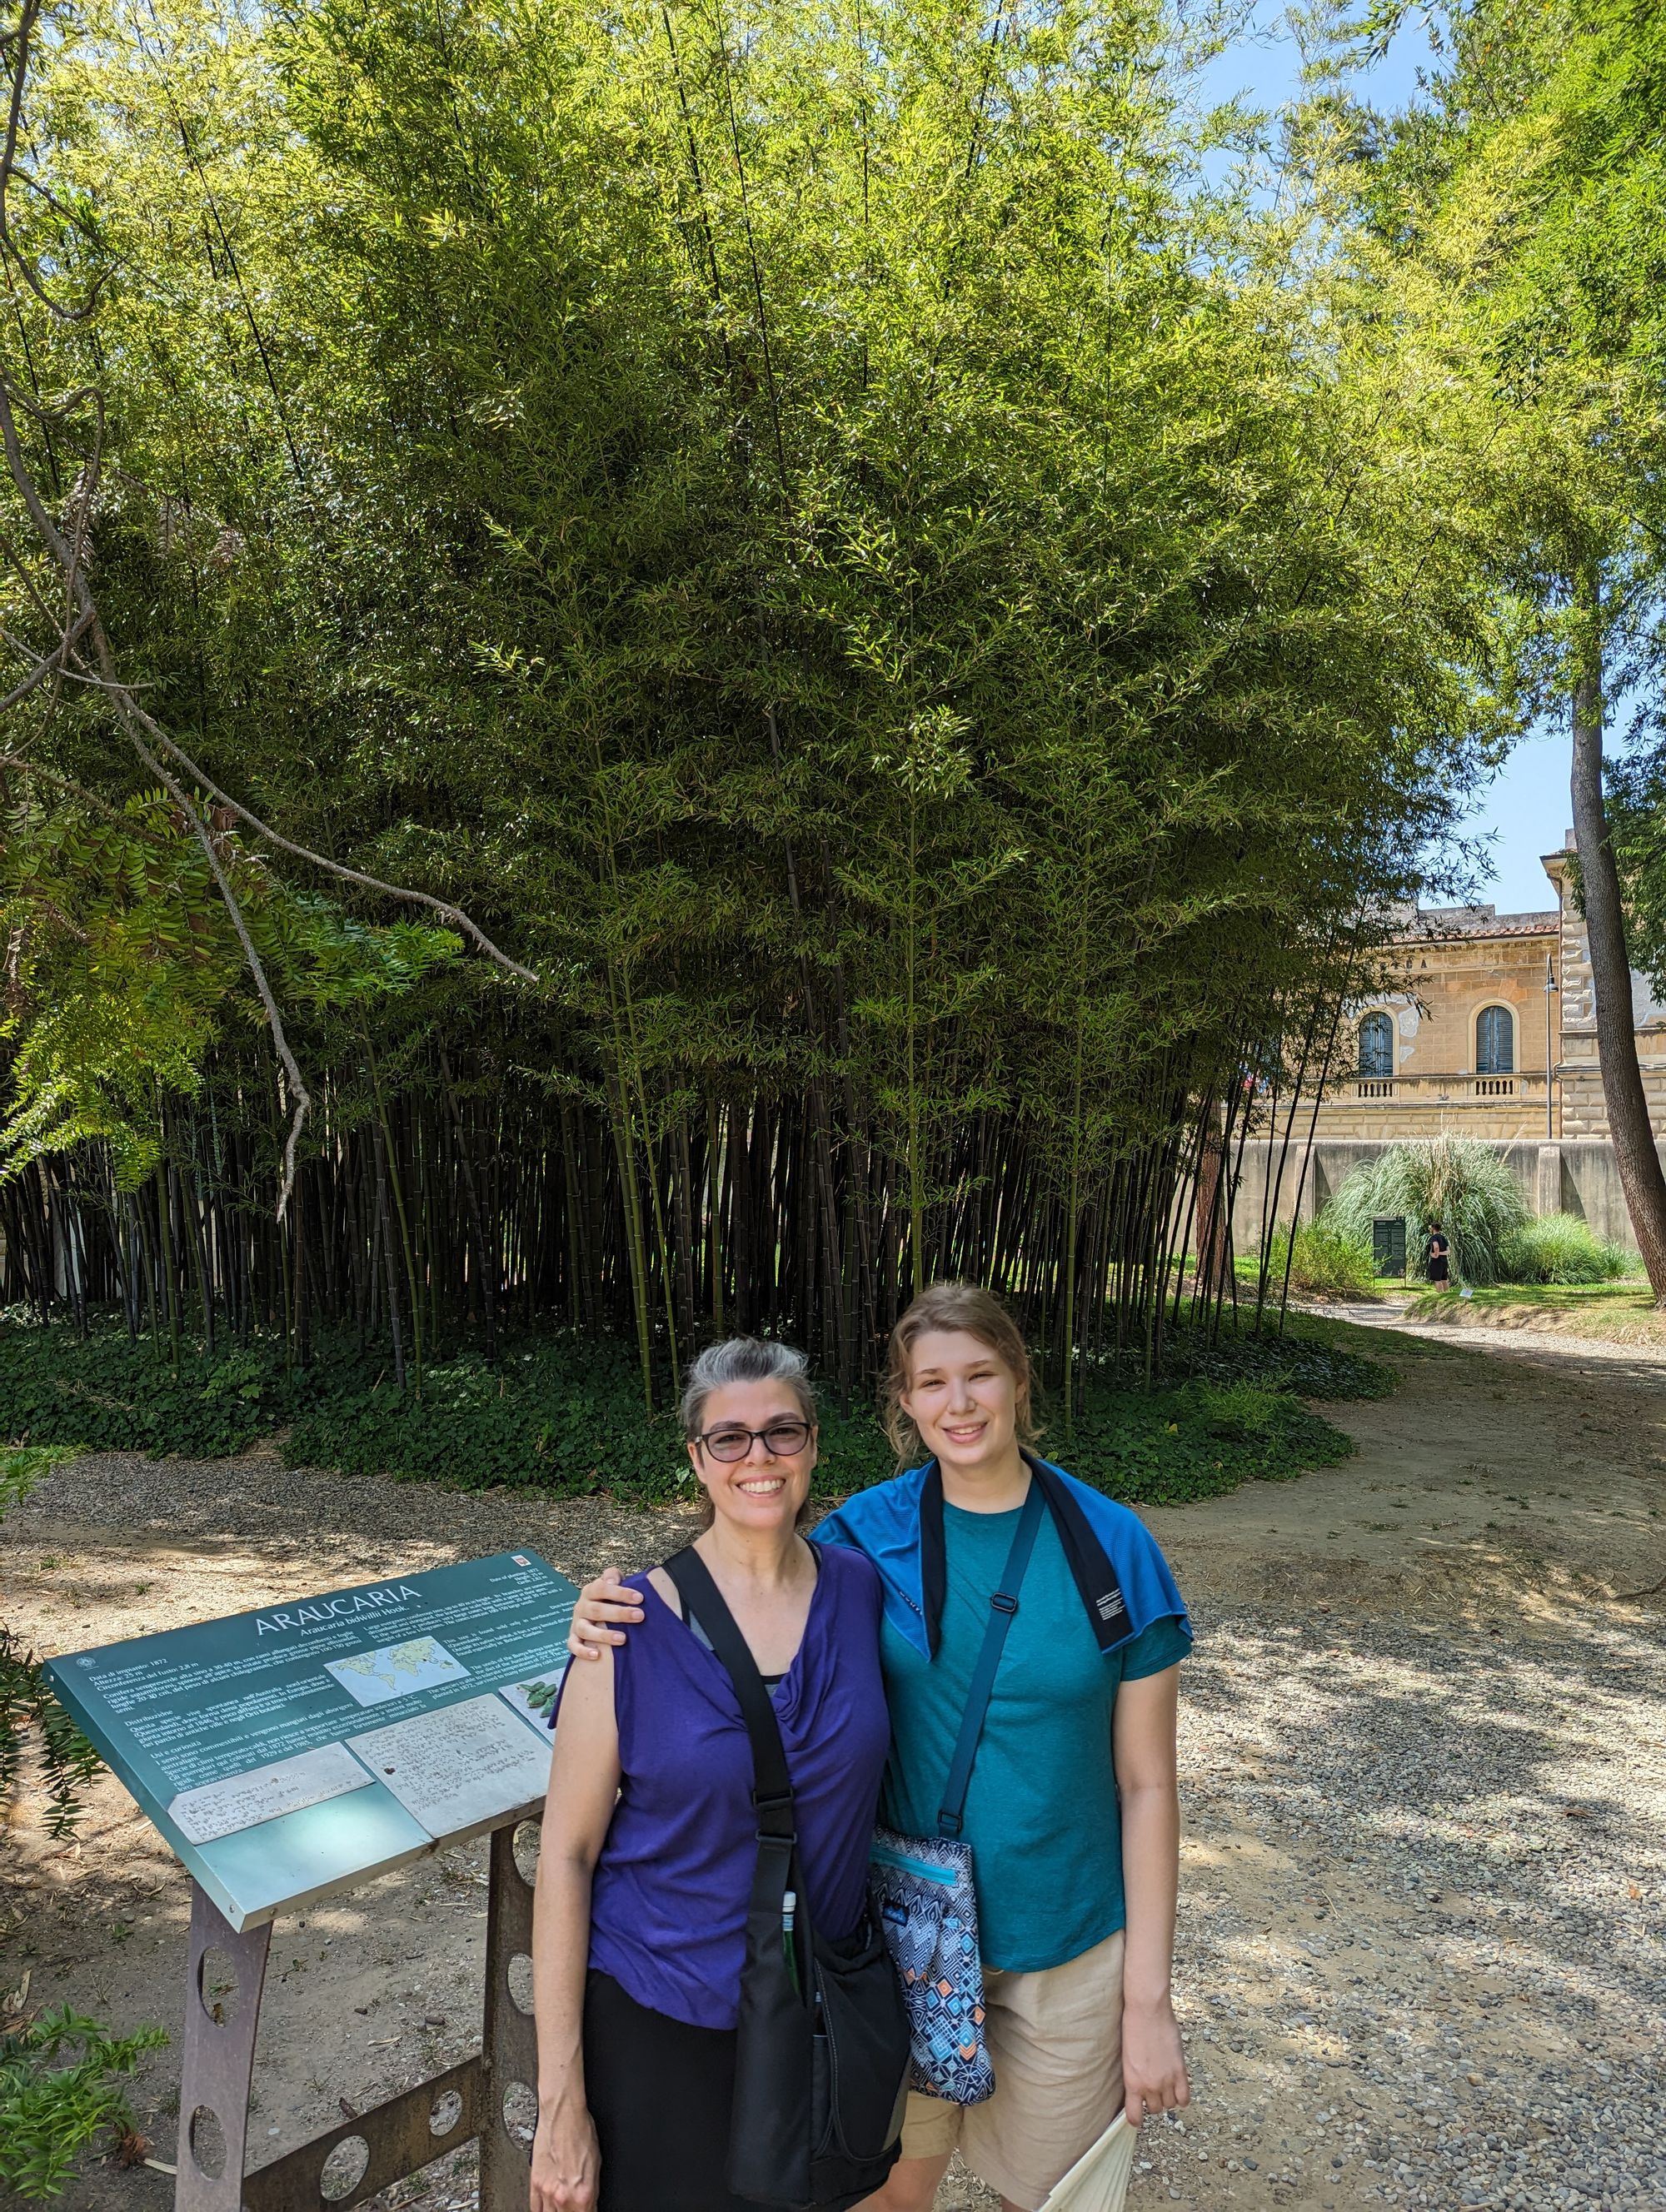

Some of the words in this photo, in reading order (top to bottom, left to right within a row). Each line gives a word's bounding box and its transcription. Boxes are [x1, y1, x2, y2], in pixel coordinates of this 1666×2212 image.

[256, 1585, 422, 1635] ARAUCARIA
[301, 1621, 350, 1636] Araucaria
[344, 1610, 382, 1624] bidwillii
[380, 1605, 410, 1615] Hook.
[115, 1664, 149, 1674] impianto:
[93, 1676, 123, 1686] Altezza:
[96, 1676, 146, 1691] Circonferenza
[157, 1667, 178, 1676] fusto:
[102, 1688, 134, 1699] Conifera
[134, 1676, 177, 1690] sempreverde
[107, 1696, 128, 1704] rigide
[130, 1682, 177, 1697] squamiformi,
[177, 1676, 202, 1685] spinose
[204, 1668, 232, 1678] all'apice.
[110, 1700, 135, 1708] lunghe
[136, 1693, 157, 1702] 20-30
[124, 1710, 173, 1726] Distribuzione
[129, 1722, 156, 1732] Questa
[159, 1715, 184, 1724] specie
[205, 1699, 239, 1711] spontanea
[133, 1721, 182, 1737] (Queensland),
[198, 1710, 220, 1719] forma
[137, 1733, 161, 1744] giunta
[161, 1726, 187, 1736] intorno
[154, 1736, 177, 1746] parchi
[184, 1726, 209, 1736] antiche
[161, 1755, 179, 1764] semi
[198, 1736, 244, 1752] commestibili
[170, 1741, 202, 1753] curiosità
[160, 1755, 200, 1771] australiani.
[164, 1766, 187, 1776] Specie
[197, 1756, 214, 1766] climi
[182, 1763, 216, 1777] esemplari
[172, 1777, 195, 1786] rigidi,
[198, 1770, 218, 1778] come
[194, 1768, 245, 1786] sopravvivenza.
